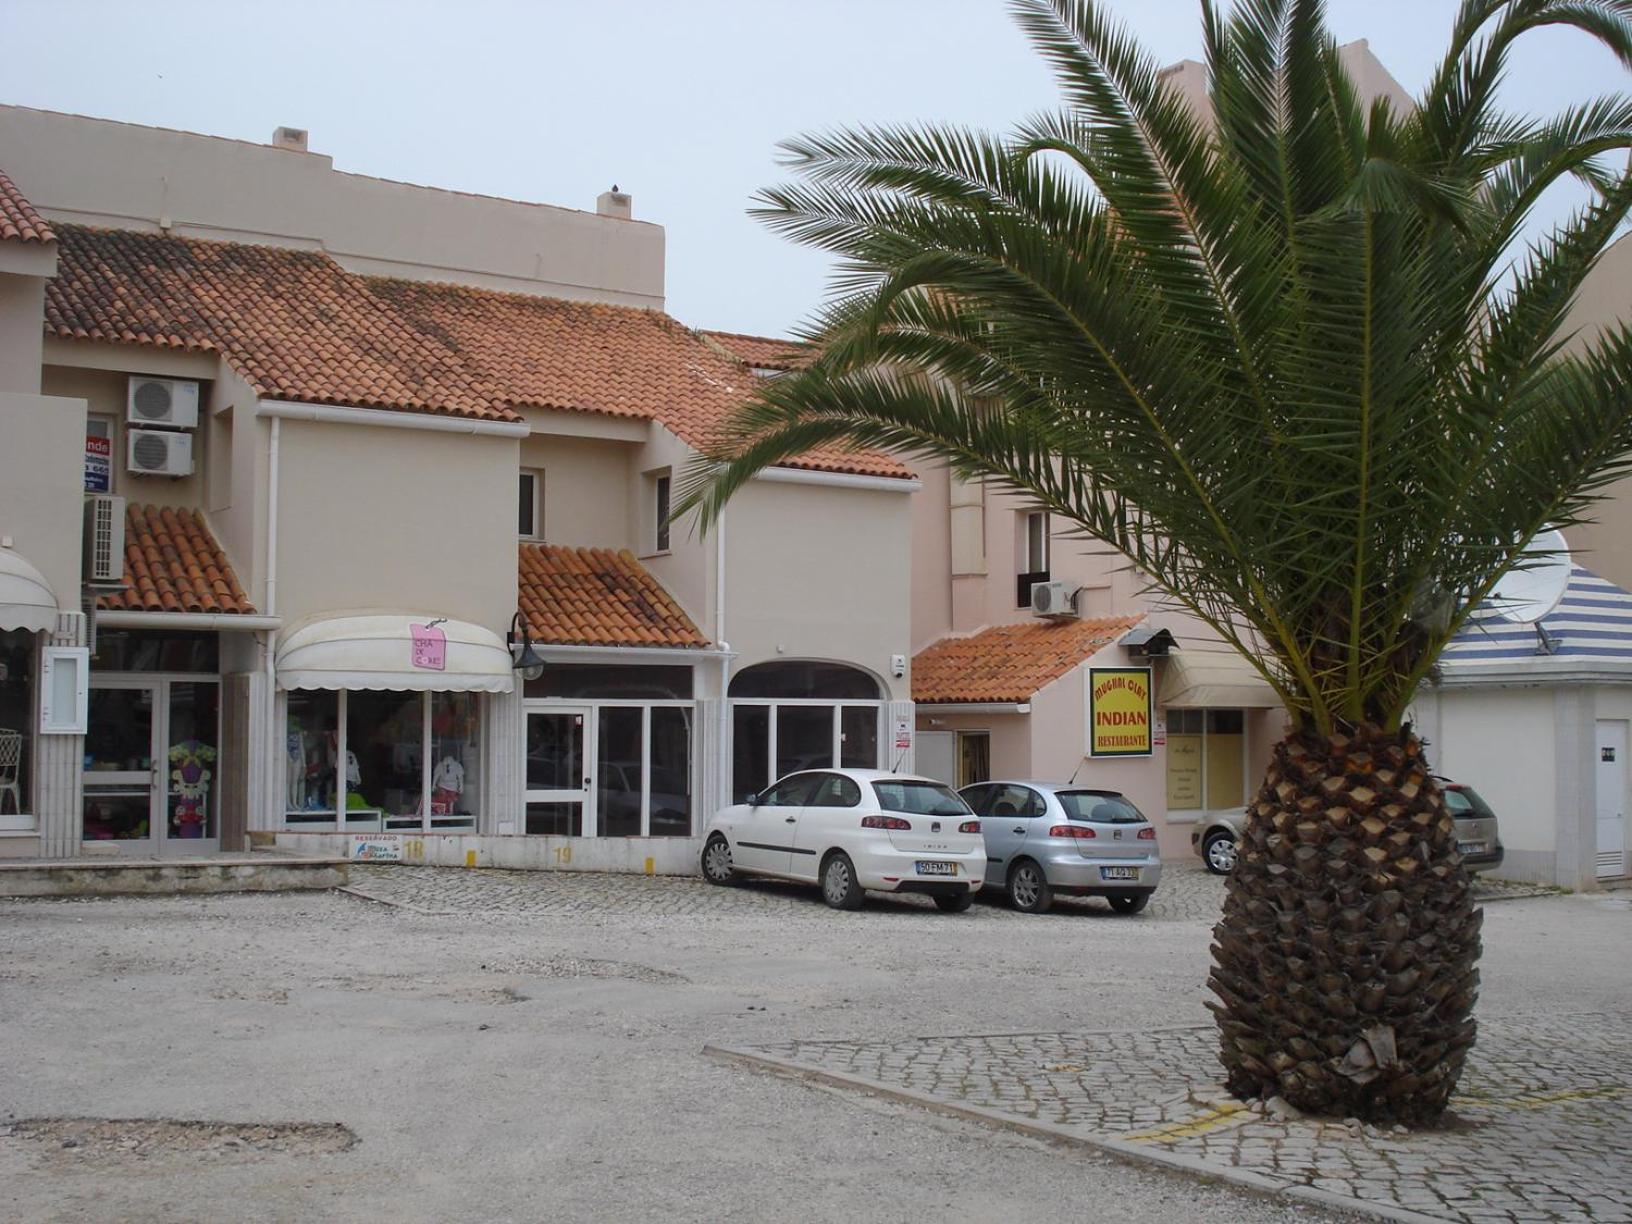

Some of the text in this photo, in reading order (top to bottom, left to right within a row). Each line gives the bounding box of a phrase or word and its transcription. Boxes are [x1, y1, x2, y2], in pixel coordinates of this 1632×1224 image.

[87, 440, 110, 453] nde
[1096, 711, 1147, 727] INDIAN
[1097, 734, 1147, 748] RESTAURANTE
[553, 846, 572, 864] 19
